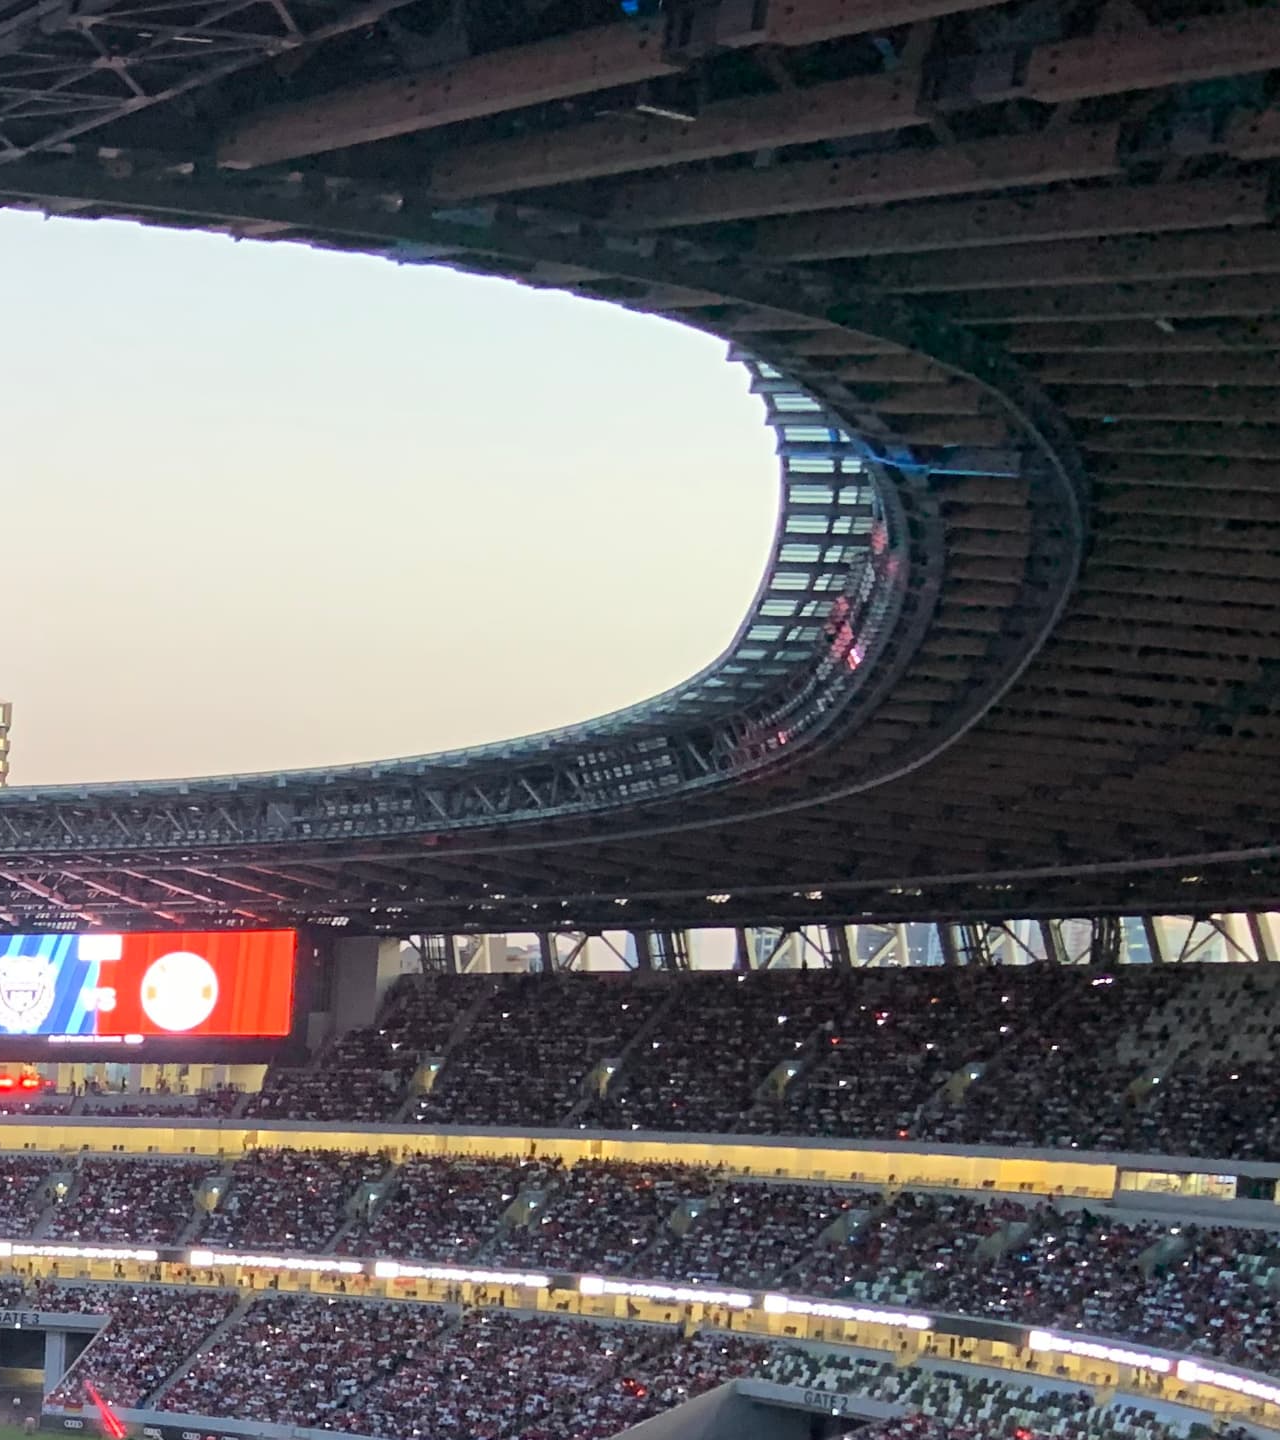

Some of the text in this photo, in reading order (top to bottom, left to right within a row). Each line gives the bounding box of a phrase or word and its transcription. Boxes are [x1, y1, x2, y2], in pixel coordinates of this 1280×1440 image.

[31, 1313, 40, 1325] 3
[804, 1391, 848, 1413] GATE 2
